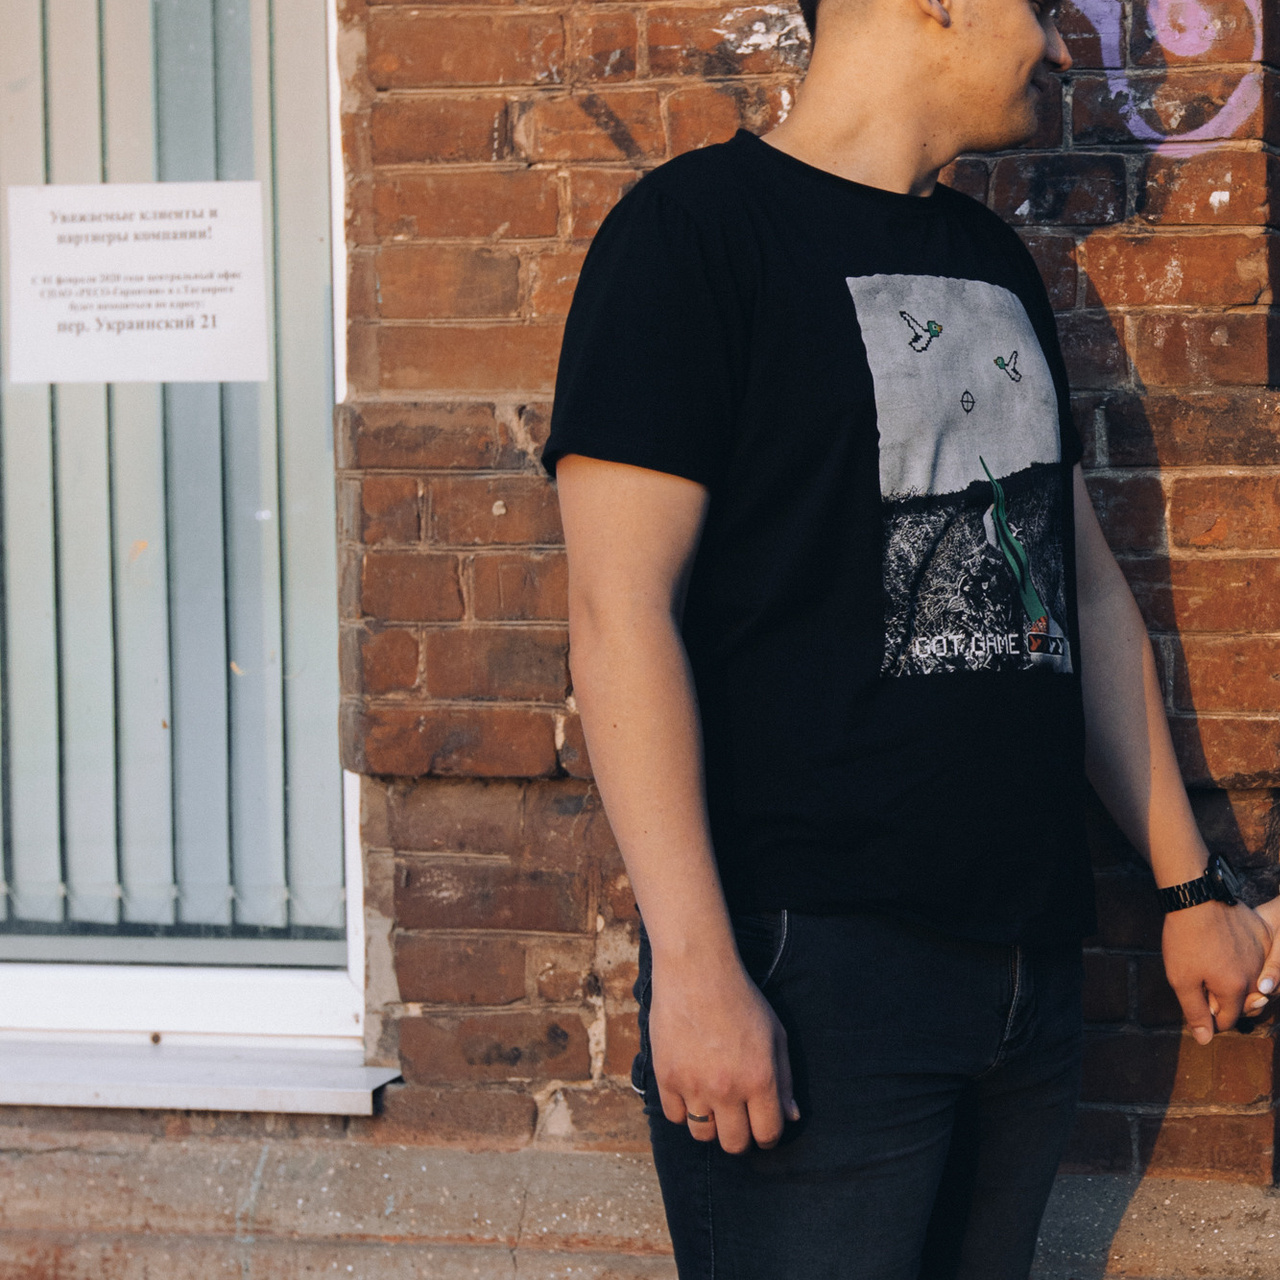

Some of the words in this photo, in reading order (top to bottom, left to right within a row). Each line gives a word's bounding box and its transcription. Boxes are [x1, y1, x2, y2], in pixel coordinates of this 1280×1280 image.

[140, 208, 204, 221] клиенты
[57, 320, 89, 336] пер.
[95, 315, 194, 335] Украинский
[200, 313, 217, 329] 21
[915, 636, 963, 658] GOT
[971, 633, 1021, 656] GAME
